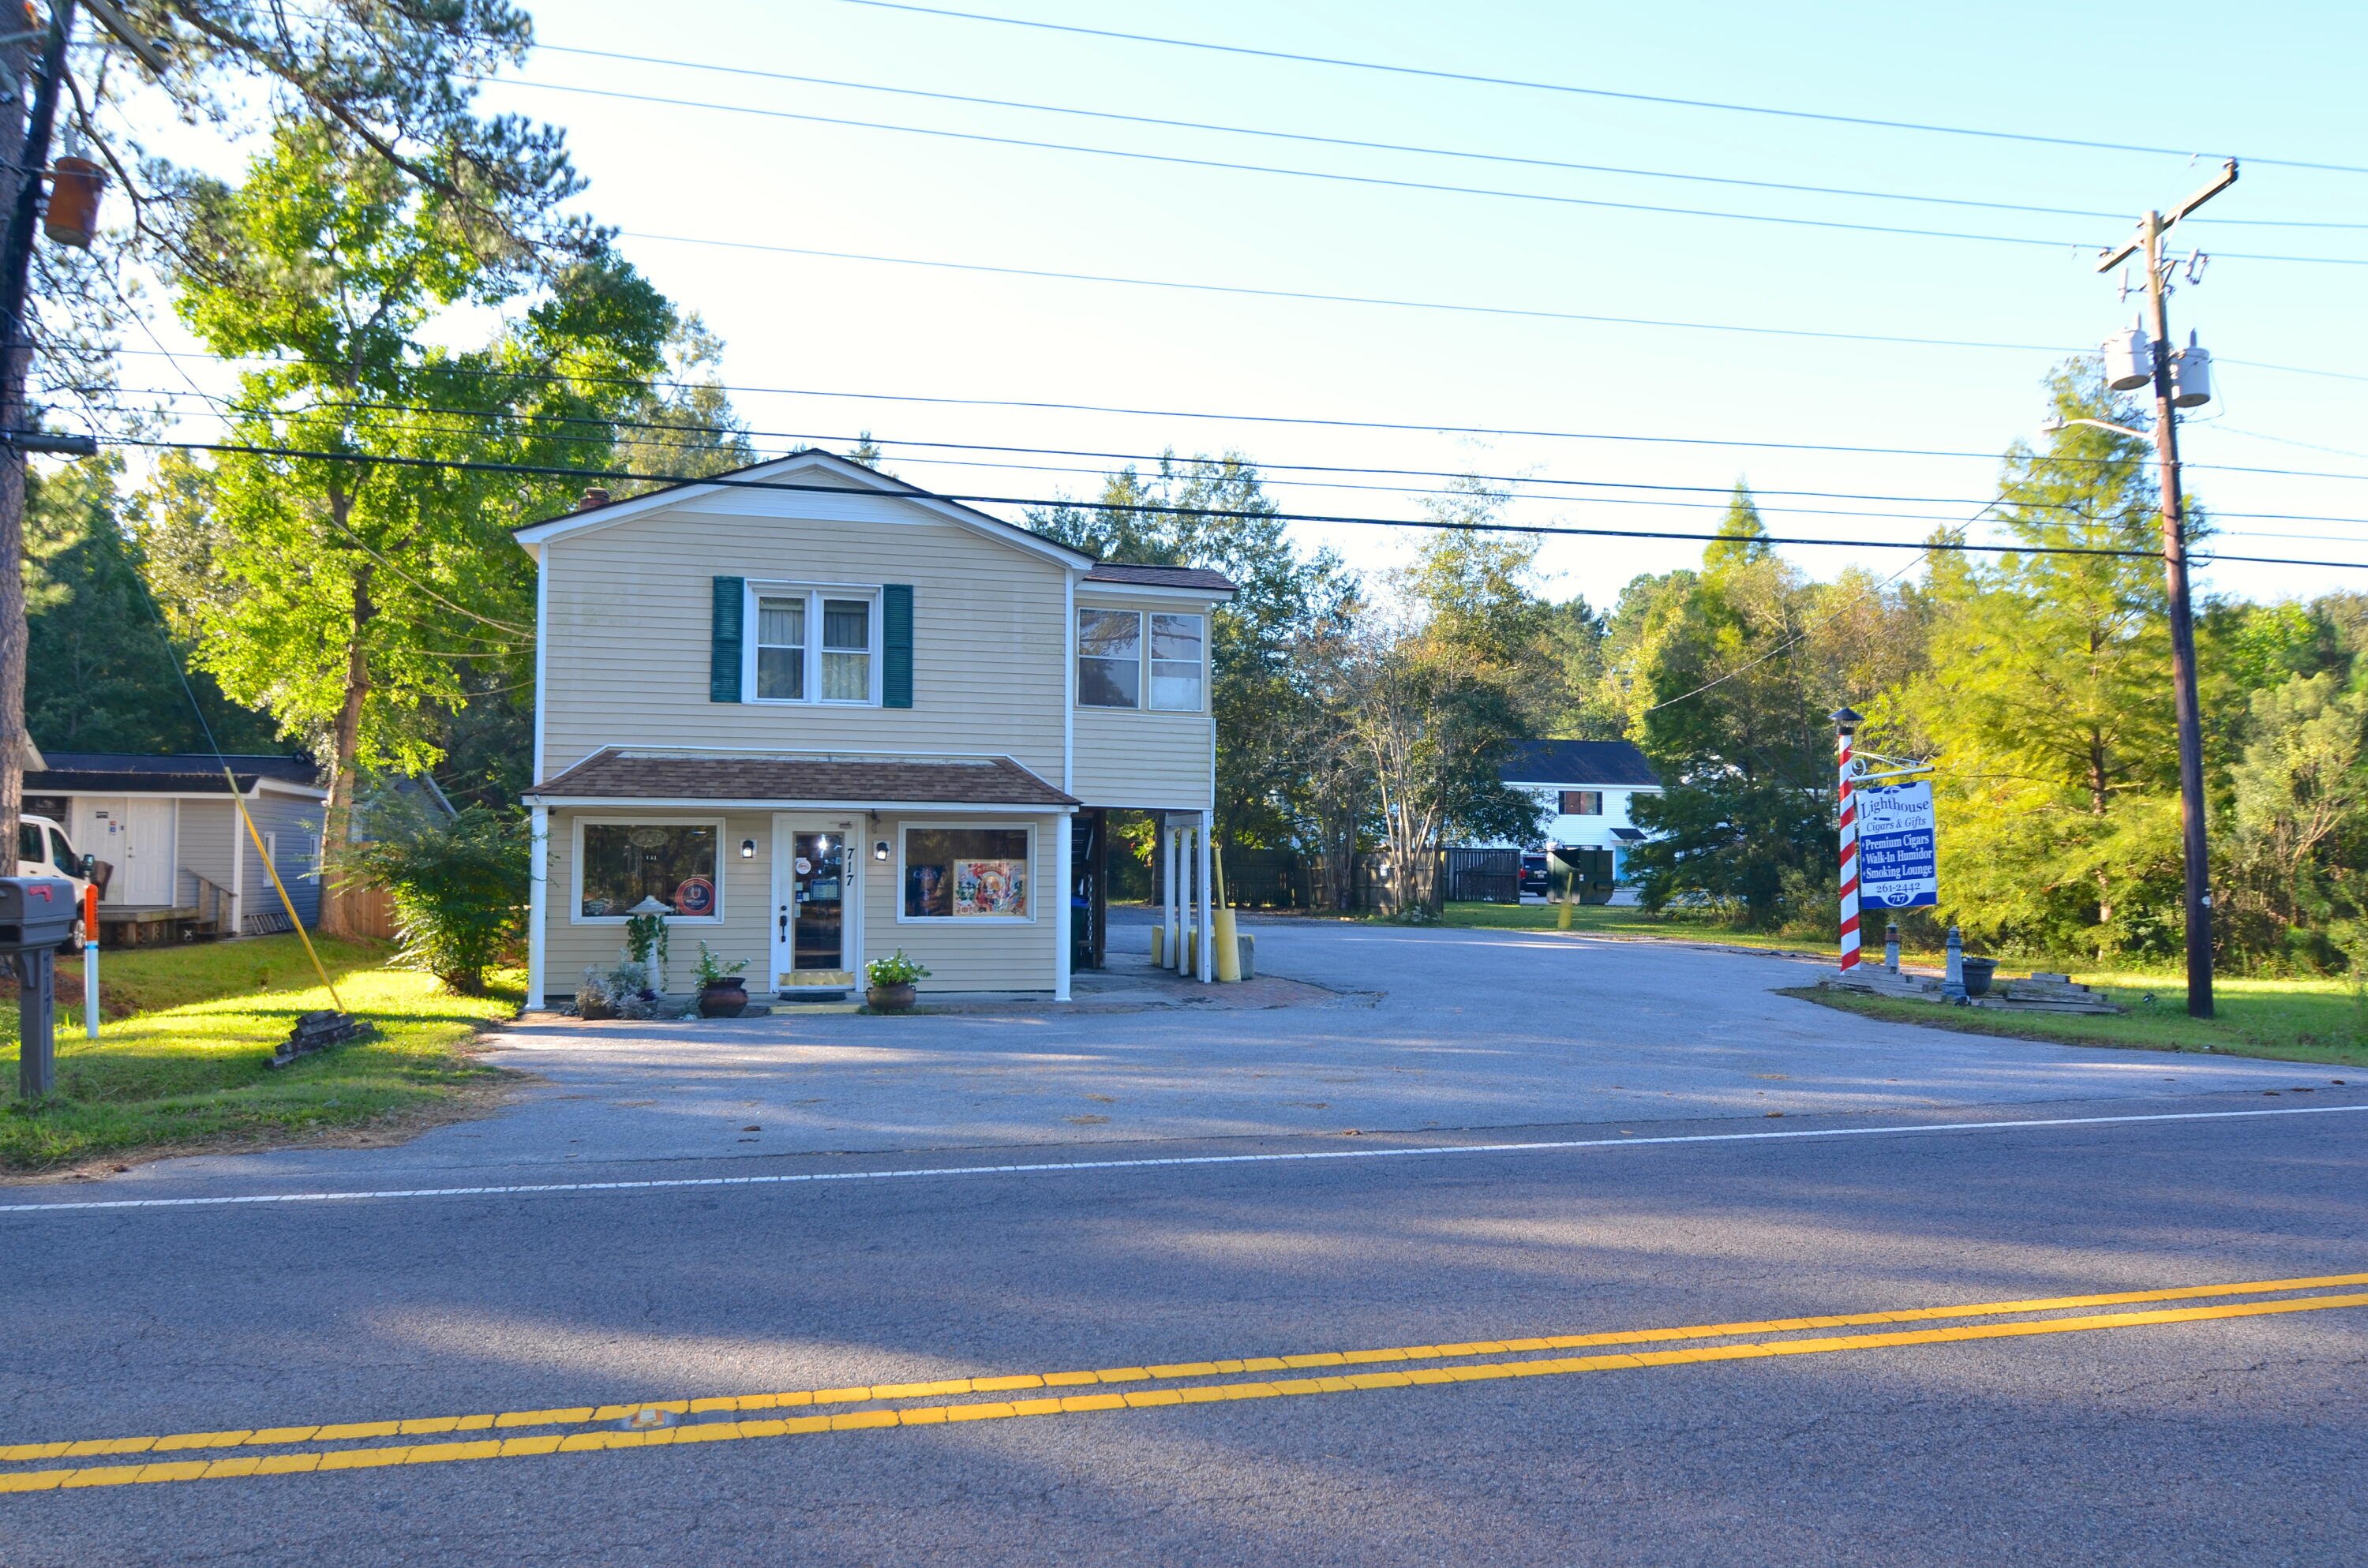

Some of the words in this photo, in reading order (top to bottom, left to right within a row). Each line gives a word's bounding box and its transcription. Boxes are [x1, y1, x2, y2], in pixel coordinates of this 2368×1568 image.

[1860, 797, 1929, 820] Lighthouse
[1867, 821, 1894, 833] Cigars
[1896, 820, 1902, 829] &
[1905, 816, 1926, 829] Gifts
[1865, 836, 1902, 850] Premium
[1903, 834, 1929, 848] Cigars
[1866, 851, 1895, 864] Walk-In
[1898, 848, 1932, 862] Humidor
[1866, 866, 1900, 879] Smoking
[1902, 864, 1932, 877] Lounge
[1876, 882, 1920, 893] 261-2442
[1890, 893, 1905, 904] 717
